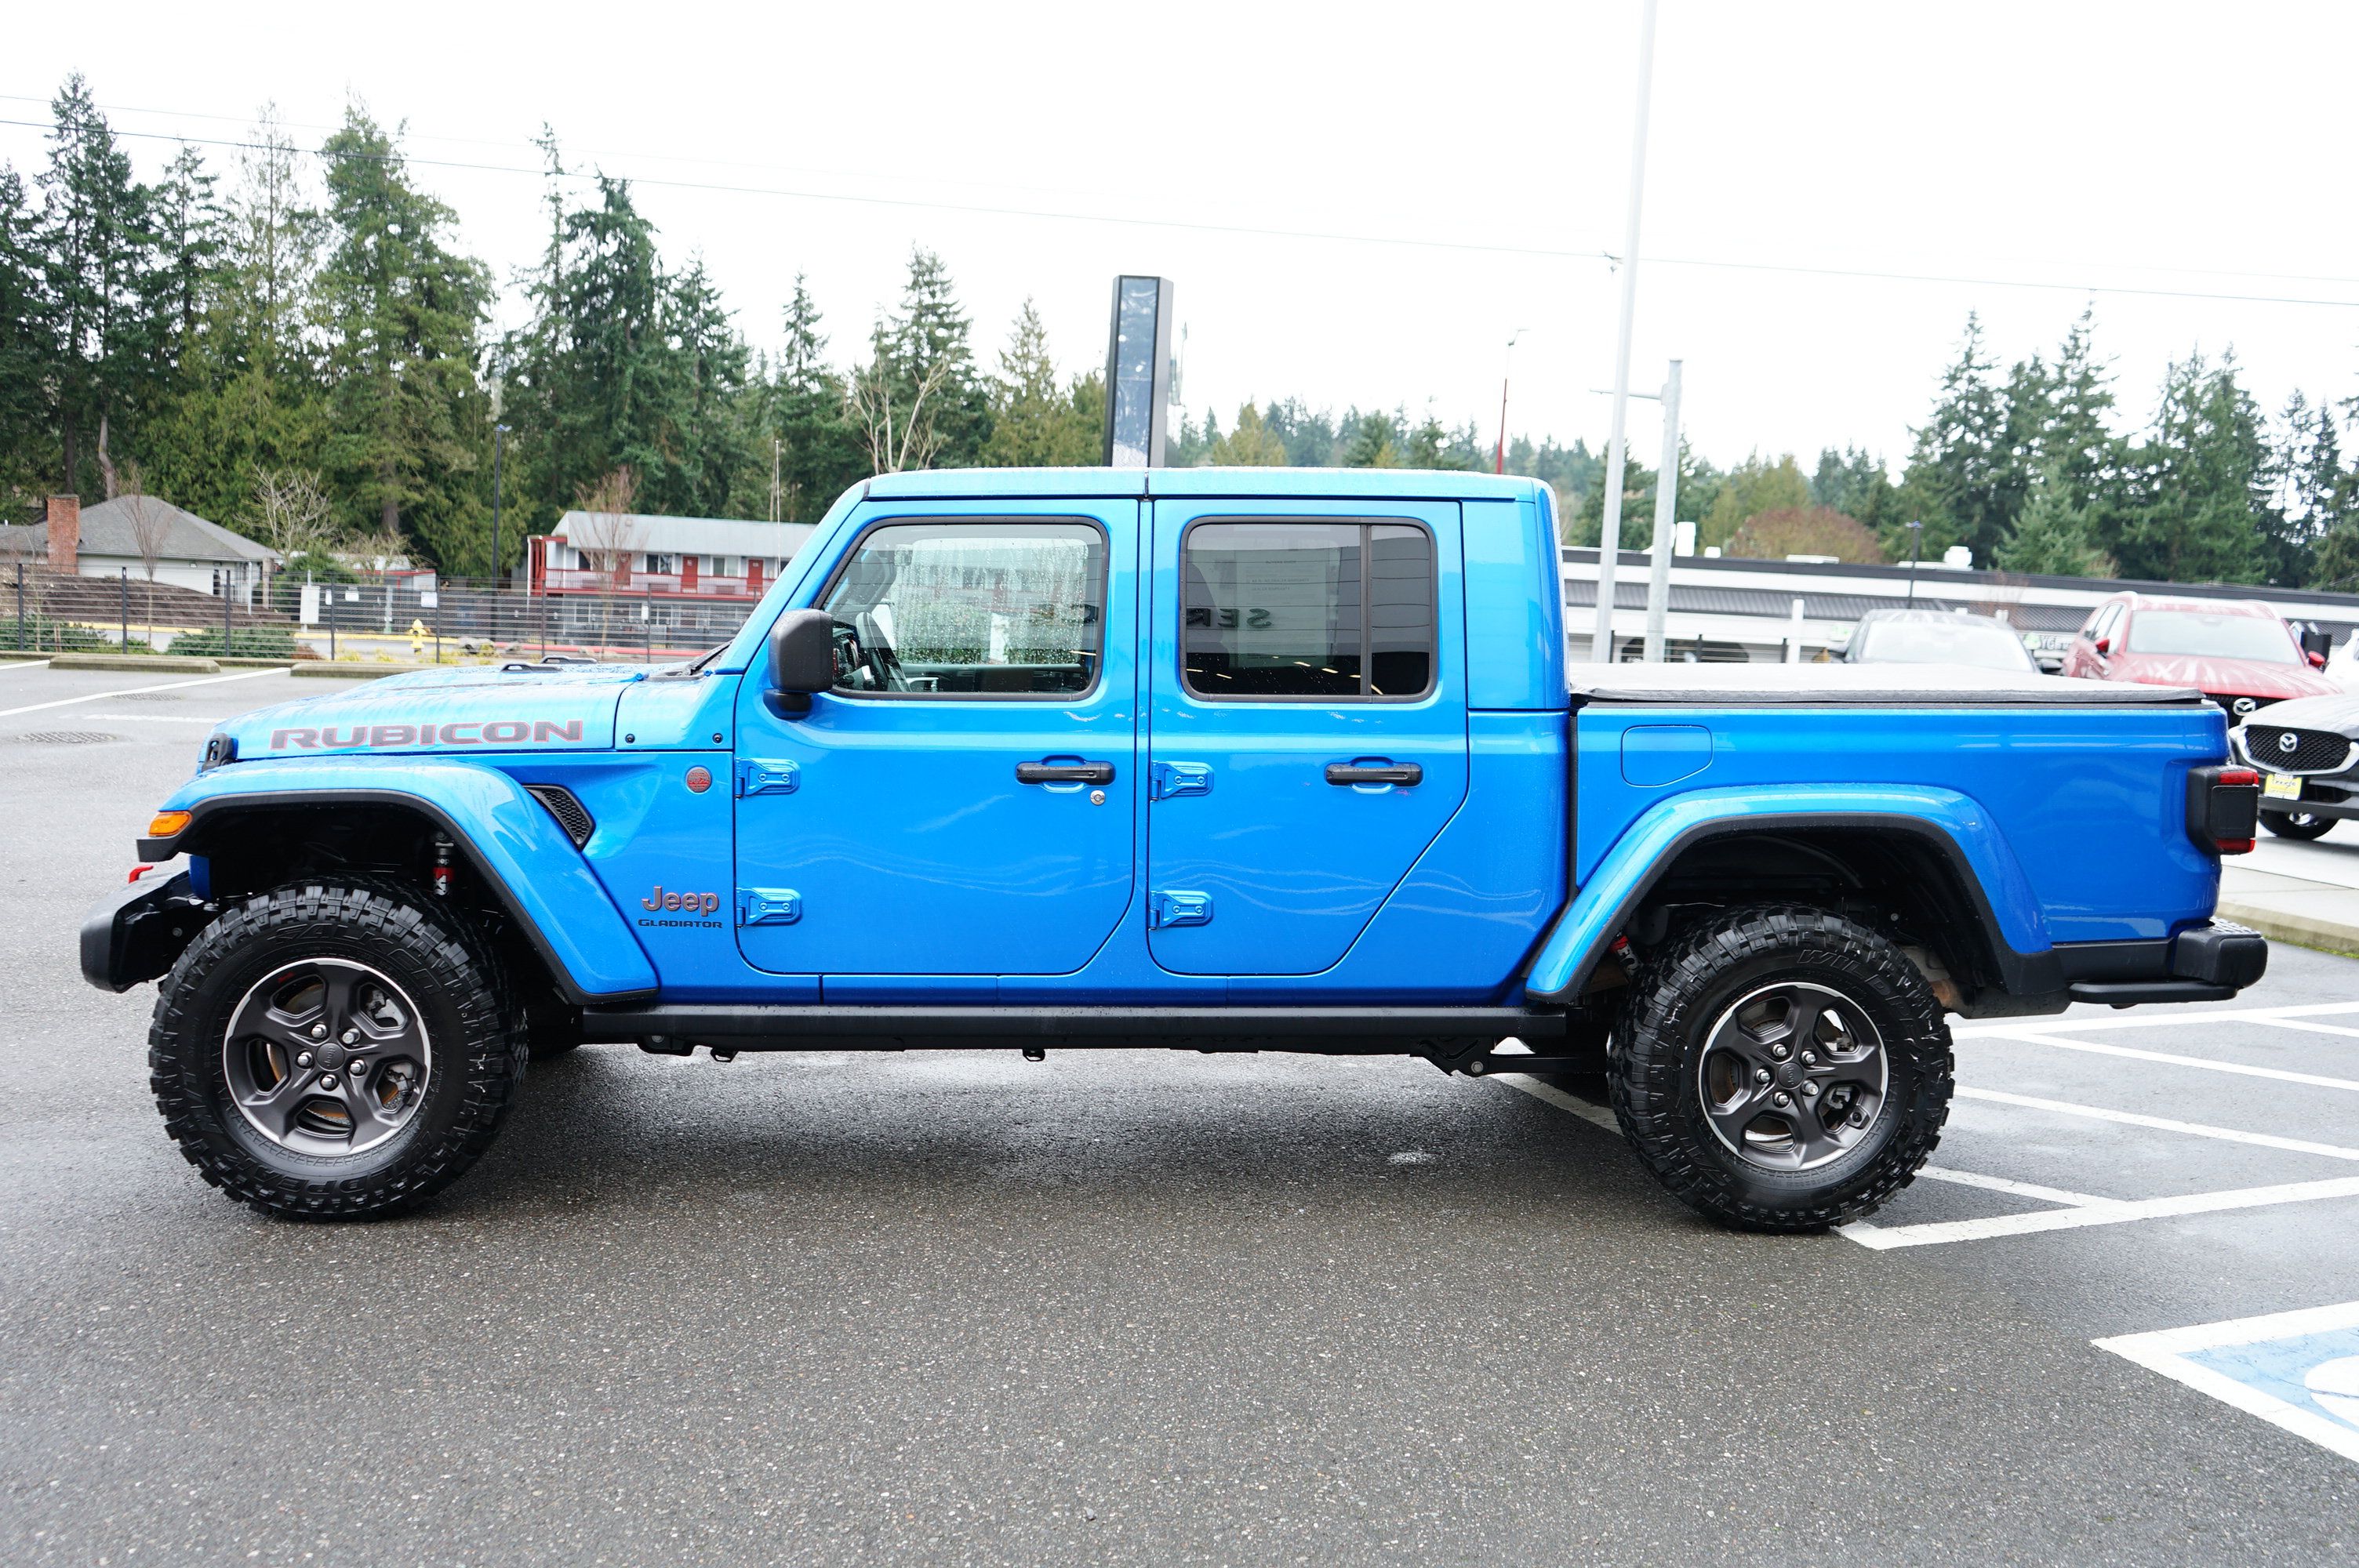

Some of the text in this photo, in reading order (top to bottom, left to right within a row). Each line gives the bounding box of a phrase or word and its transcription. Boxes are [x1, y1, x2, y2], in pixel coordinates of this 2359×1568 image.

[269, 720, 583, 750] RUBICON
[641, 885, 719, 917] Jeep
[638, 919, 723, 929] GLADIATOR
